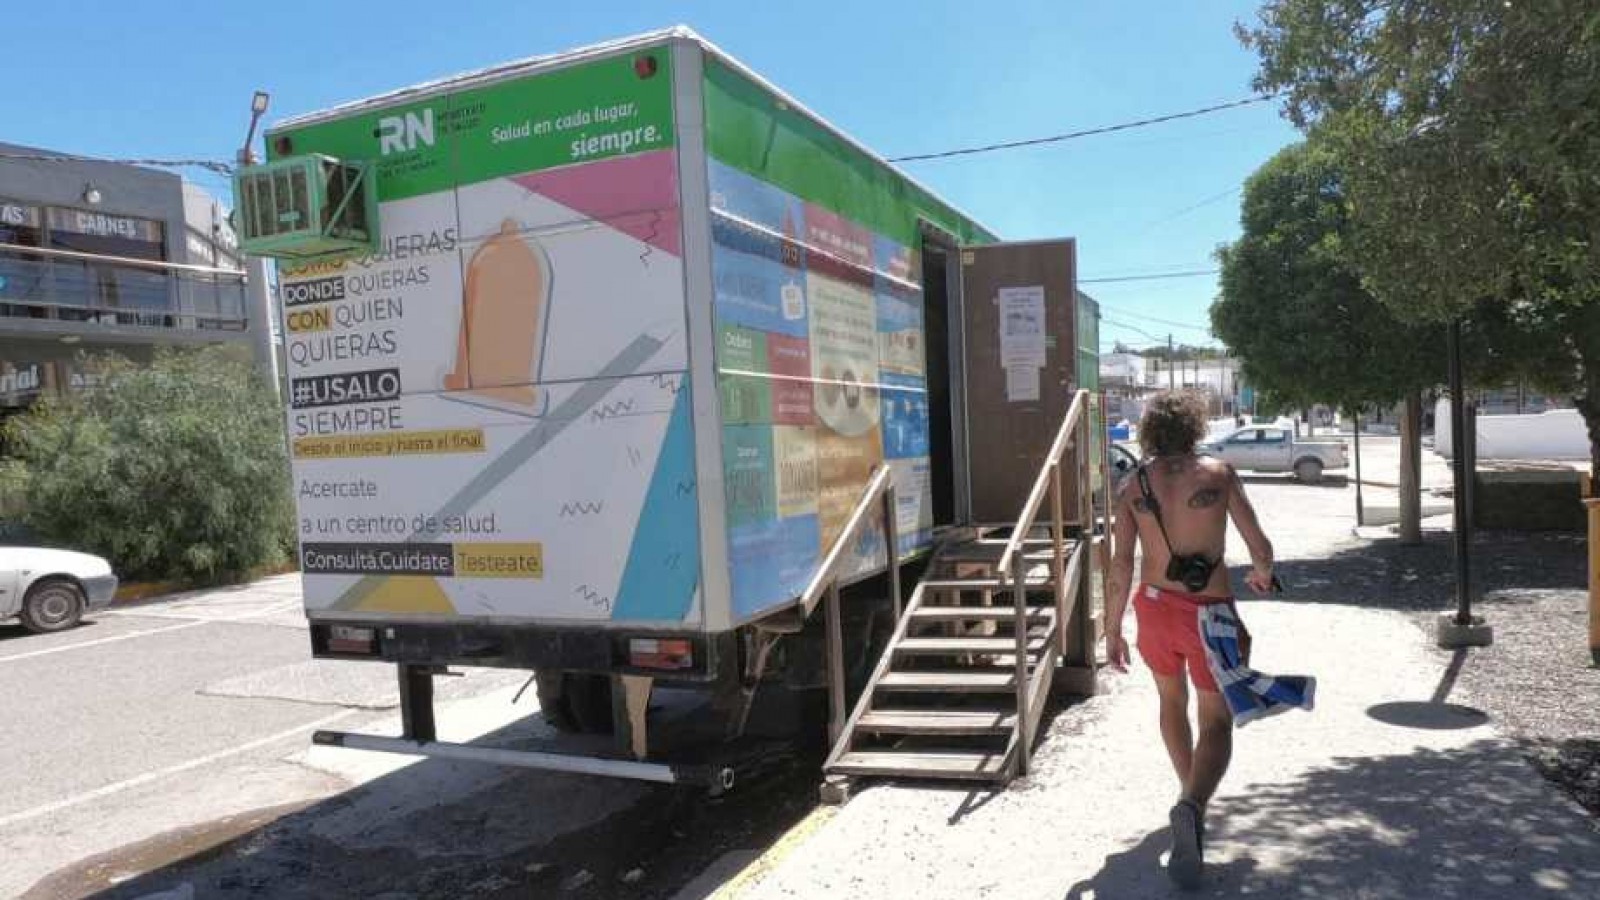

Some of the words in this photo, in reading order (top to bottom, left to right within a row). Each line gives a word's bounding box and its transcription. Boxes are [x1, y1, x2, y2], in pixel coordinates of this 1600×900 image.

[491, 120, 530, 144] Salud
[533, 119, 550, 135] en
[555, 109, 591, 130] cada
[594, 102, 639, 124] lugar,
[570, 124, 663, 157] siempre.
[285, 278, 344, 304] DONDE
[347, 266, 430, 295] QUIERAS
[286, 307, 330, 331] CON
[335, 297, 403, 328] QUIEN
[290, 330, 397, 367] QUIERAS
[294, 371, 400, 403] #USALO
[294, 406, 404, 436] SIEMPRE
[300, 478, 378, 499] Acercate
[302, 520, 312, 534] a
[317, 518, 340, 534] un
[345, 515, 407, 533] centro
[412, 513, 438, 533] de
[442, 512, 502, 533] salud.
